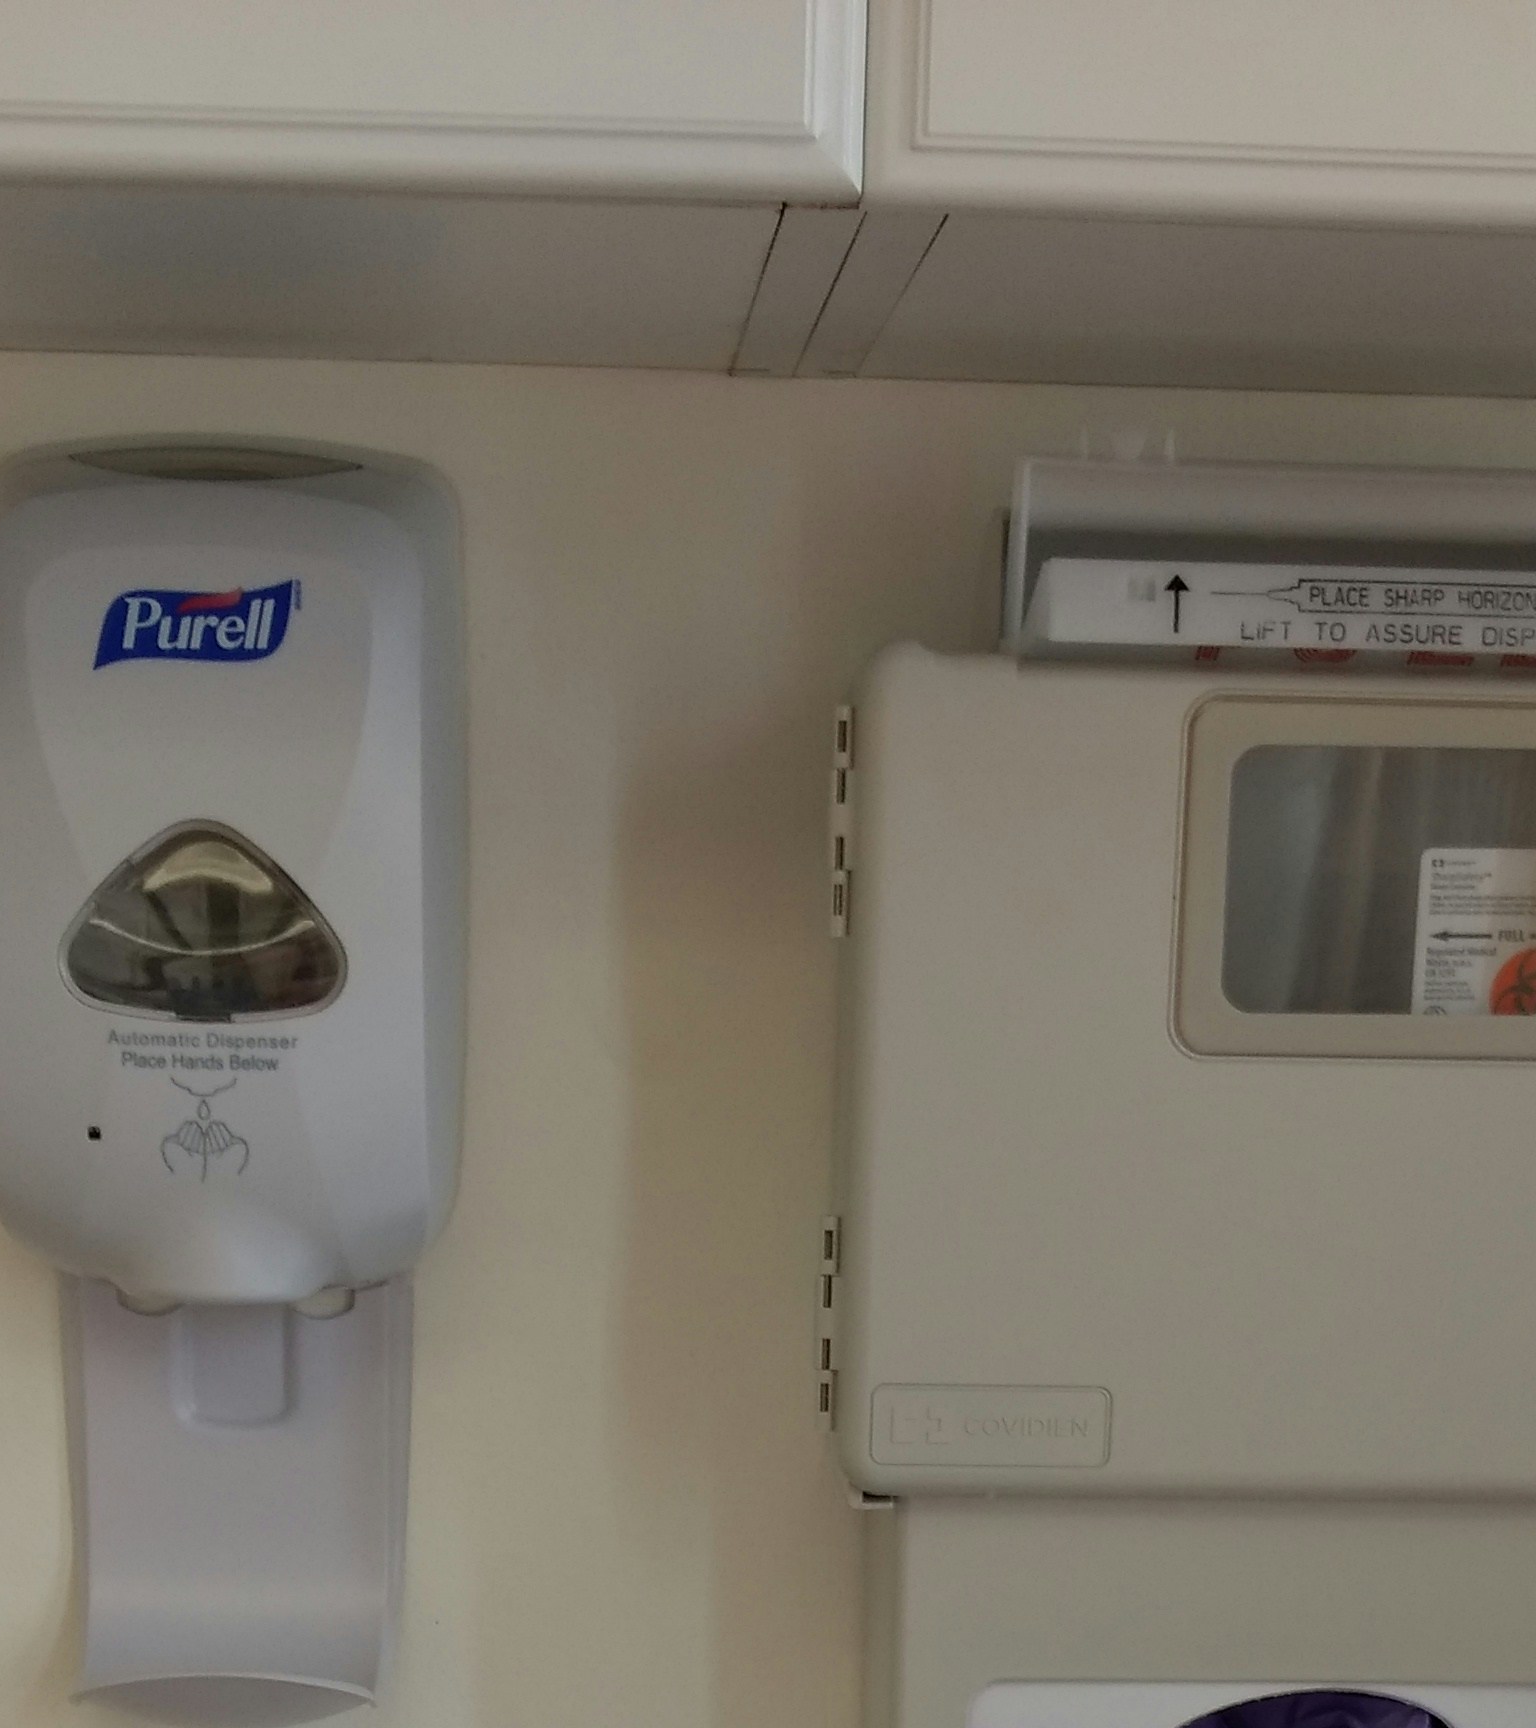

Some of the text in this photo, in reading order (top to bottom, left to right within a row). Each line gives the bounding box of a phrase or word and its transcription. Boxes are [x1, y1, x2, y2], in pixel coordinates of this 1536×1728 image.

[1309, 586, 1370, 608] PLACE
[1383, 588, 1445, 609] SHARP
[121, 597, 276, 650] Purell
[1239, 620, 1292, 641] LIFT
[1315, 621, 1347, 642] TO
[1365, 623, 1463, 646] ASSURE
[107, 1030, 298, 1051] Automatic Dispenser
[121, 1051, 279, 1071] Place Hands Below
[964, 1416, 1088, 1437] COVIDIEN
